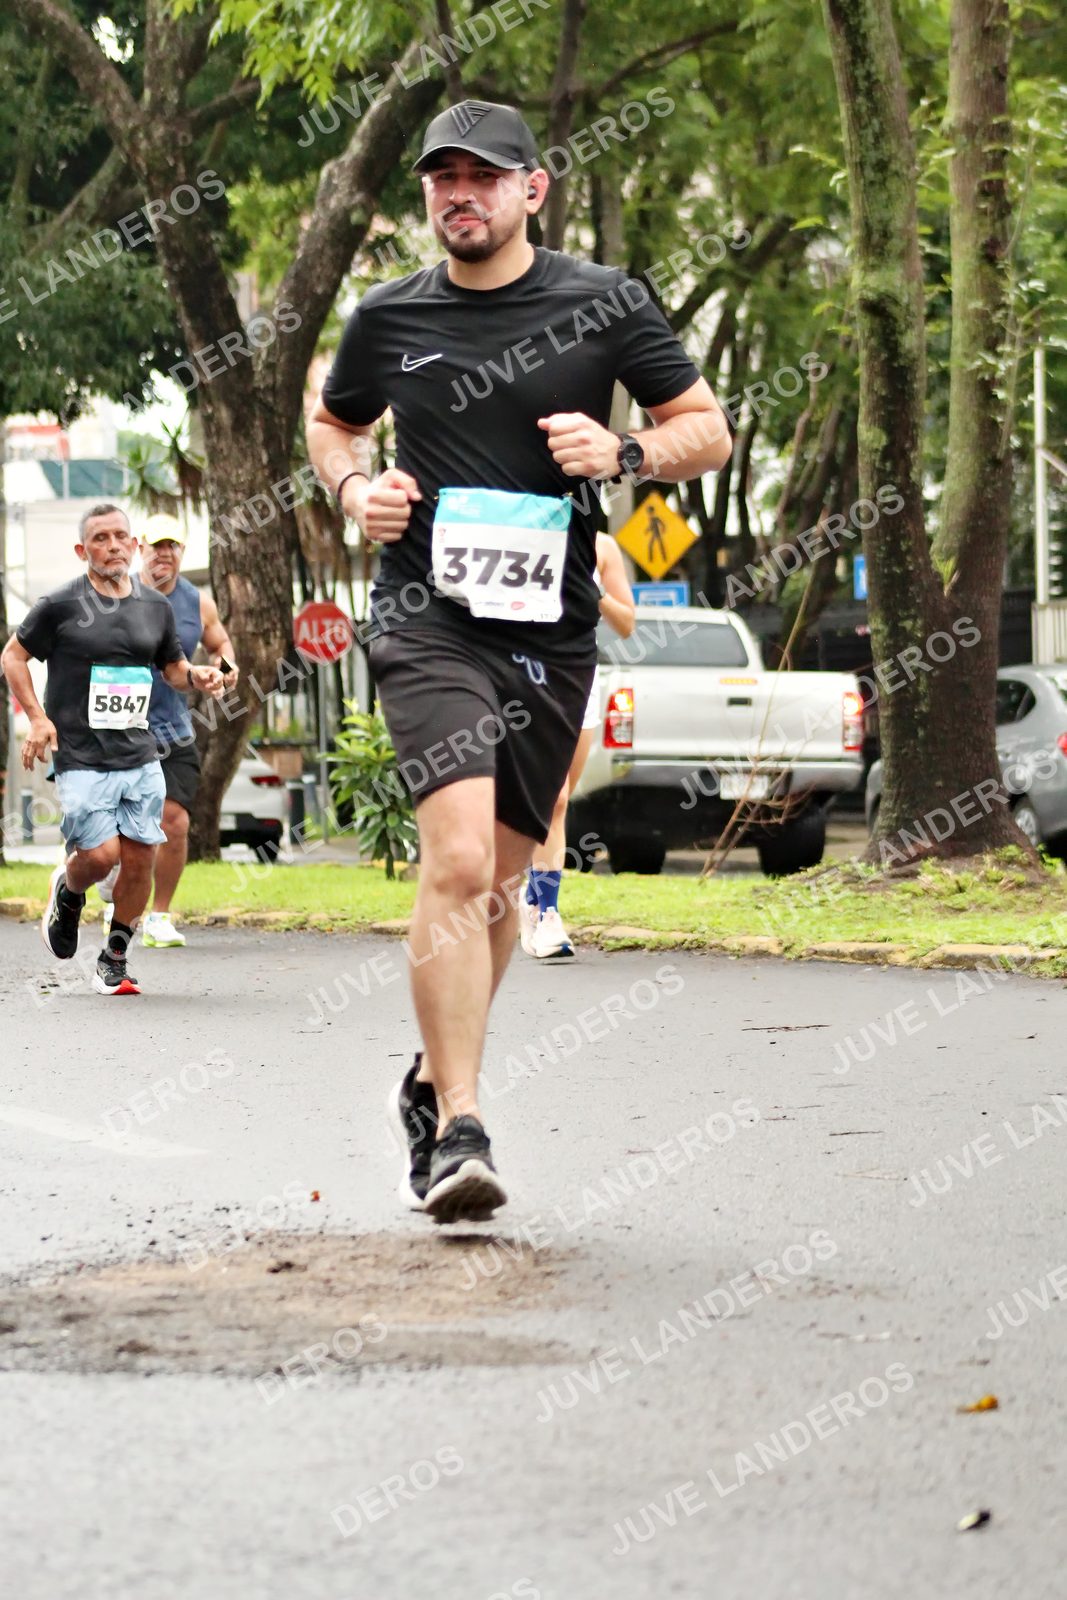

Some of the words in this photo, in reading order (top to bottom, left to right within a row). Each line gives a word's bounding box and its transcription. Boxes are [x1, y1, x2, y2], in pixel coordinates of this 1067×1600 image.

[442, 547, 554, 591] 3734
[298, 619, 347, 644] ALTO
[94, 695, 147, 713] 5847
